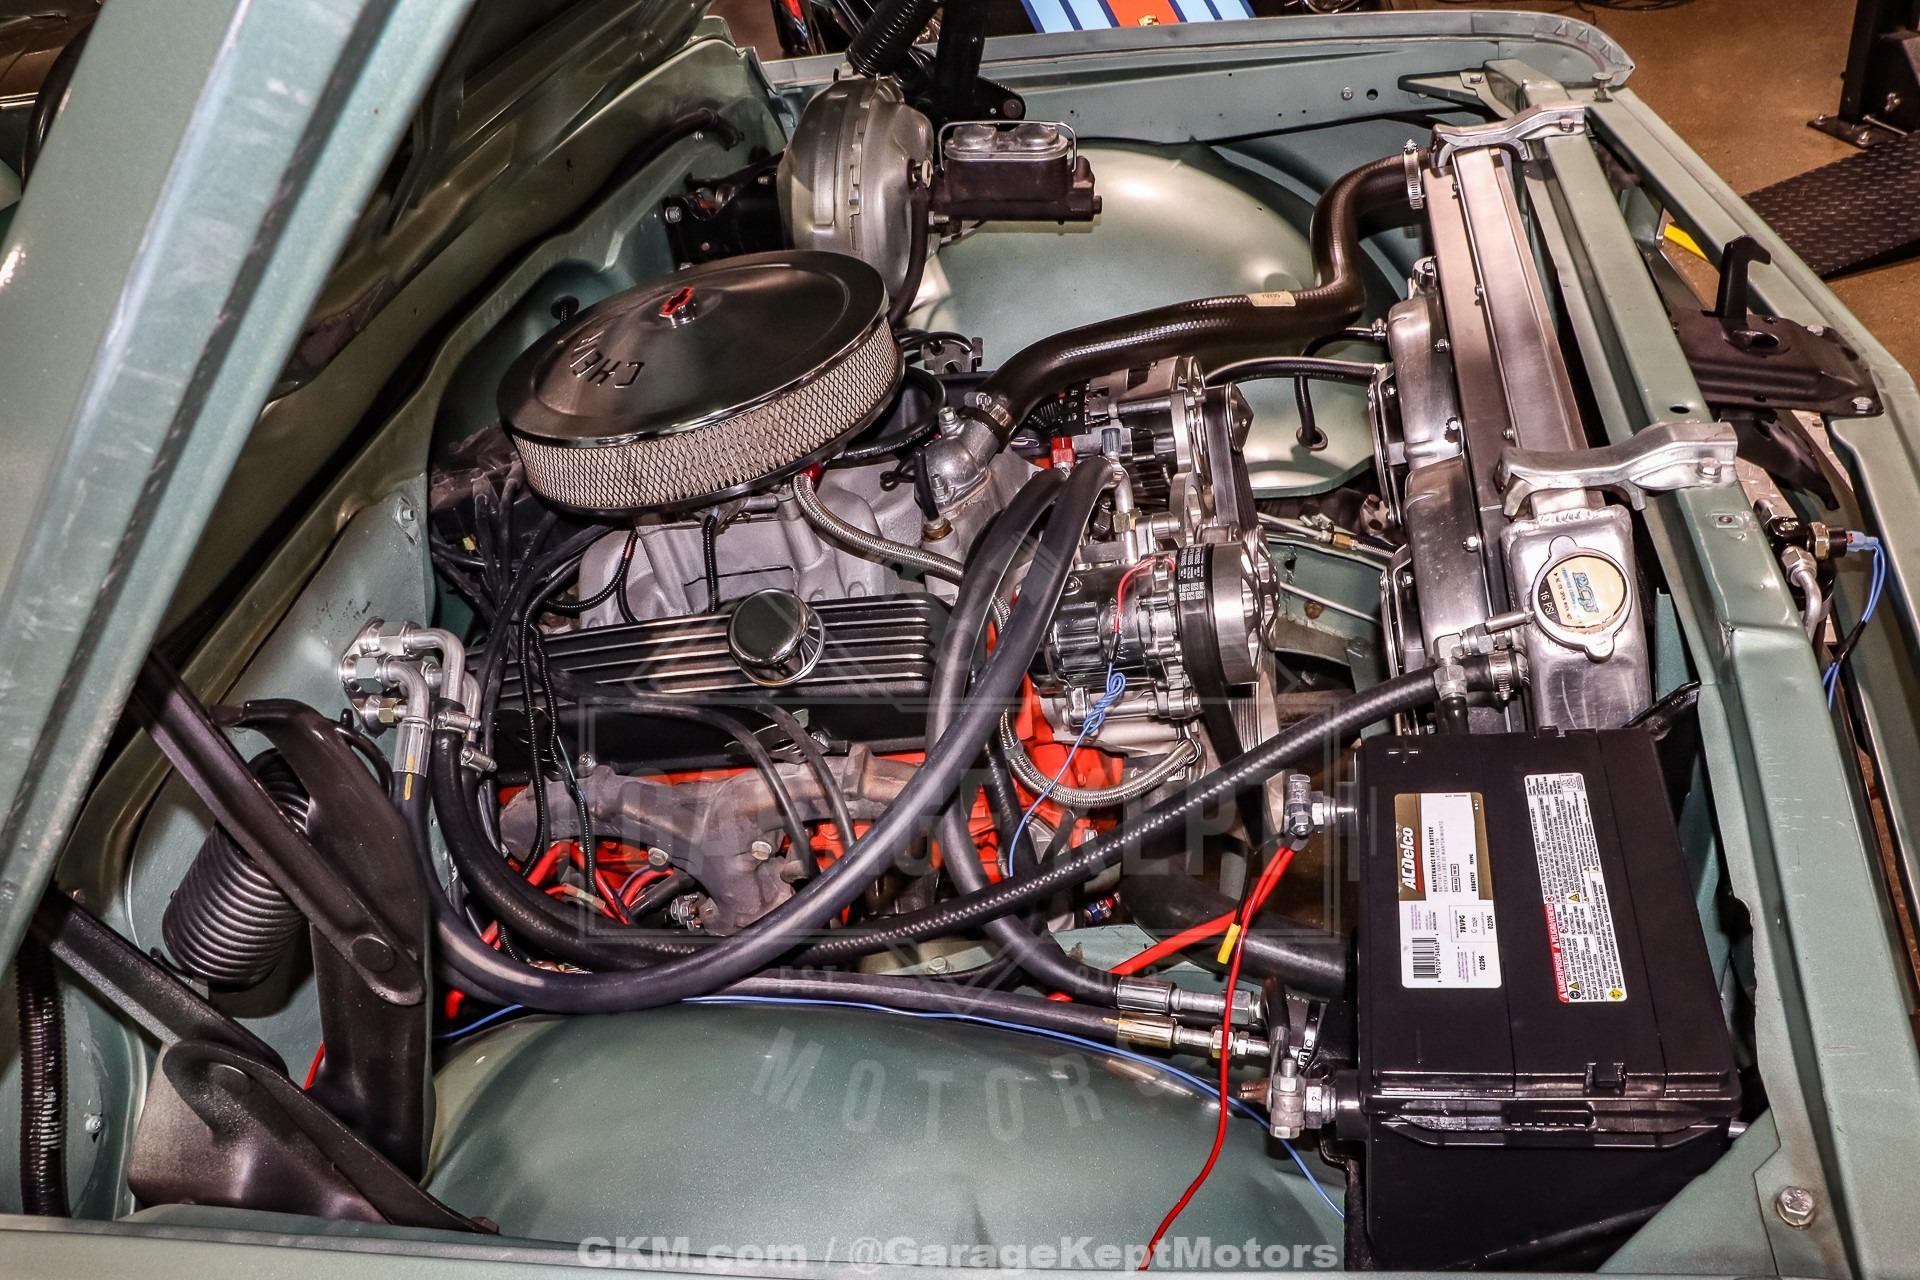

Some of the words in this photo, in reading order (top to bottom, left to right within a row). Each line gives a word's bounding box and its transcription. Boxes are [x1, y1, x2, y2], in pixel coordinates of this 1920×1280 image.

[1540, 591, 1550, 601] 16
[1544, 602, 1554, 615] PSI
[1399, 827, 1415, 889] ACDelco
